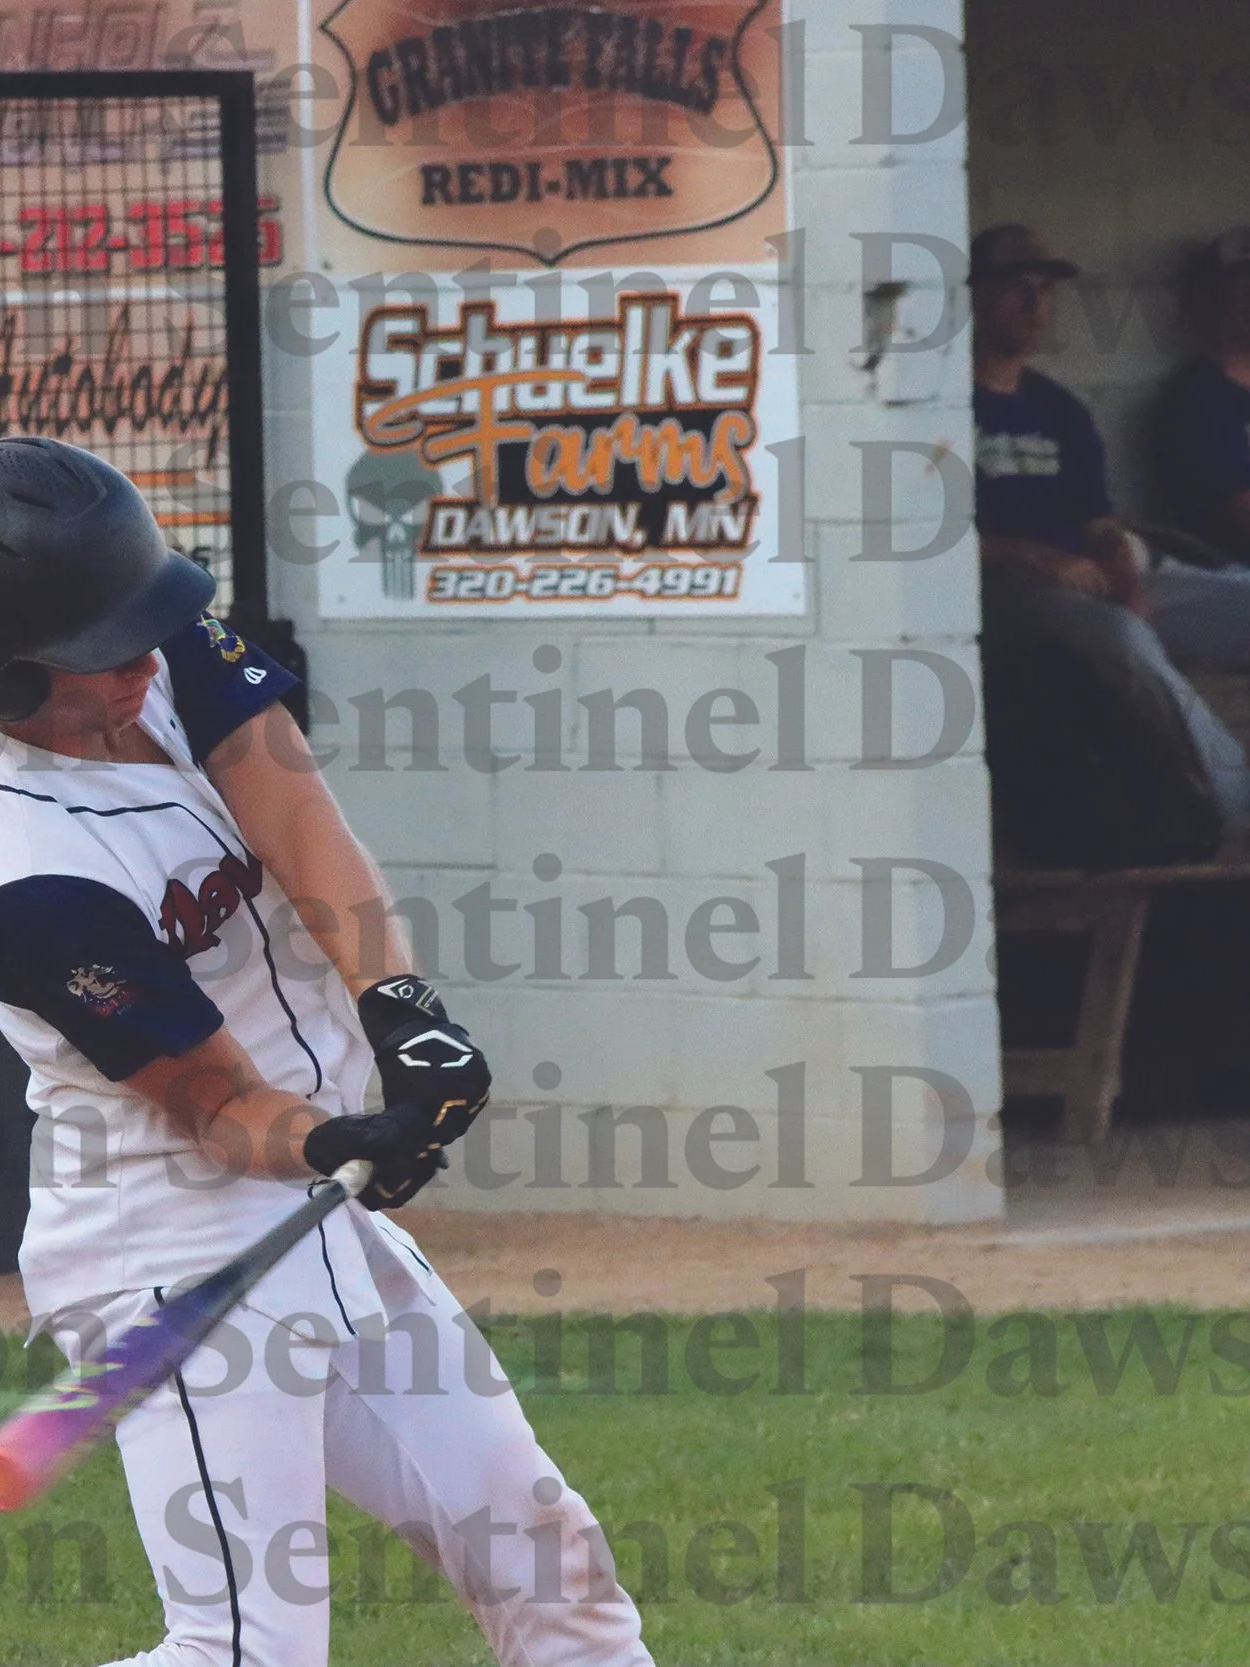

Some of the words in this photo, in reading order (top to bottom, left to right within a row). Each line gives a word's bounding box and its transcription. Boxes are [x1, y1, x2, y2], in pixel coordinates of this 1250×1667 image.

[368, 9, 574, 126] GRANITE
[582, 11, 728, 116] FALLS
[420, 156, 674, 206] REDI-MIX
[360, 295, 759, 414] Schuelke
[367, 368, 753, 503] Farms
[434, 503, 646, 547] DAWSON,
[662, 501, 749, 547] MN
[432, 568, 740, 598] 320-226-4991
